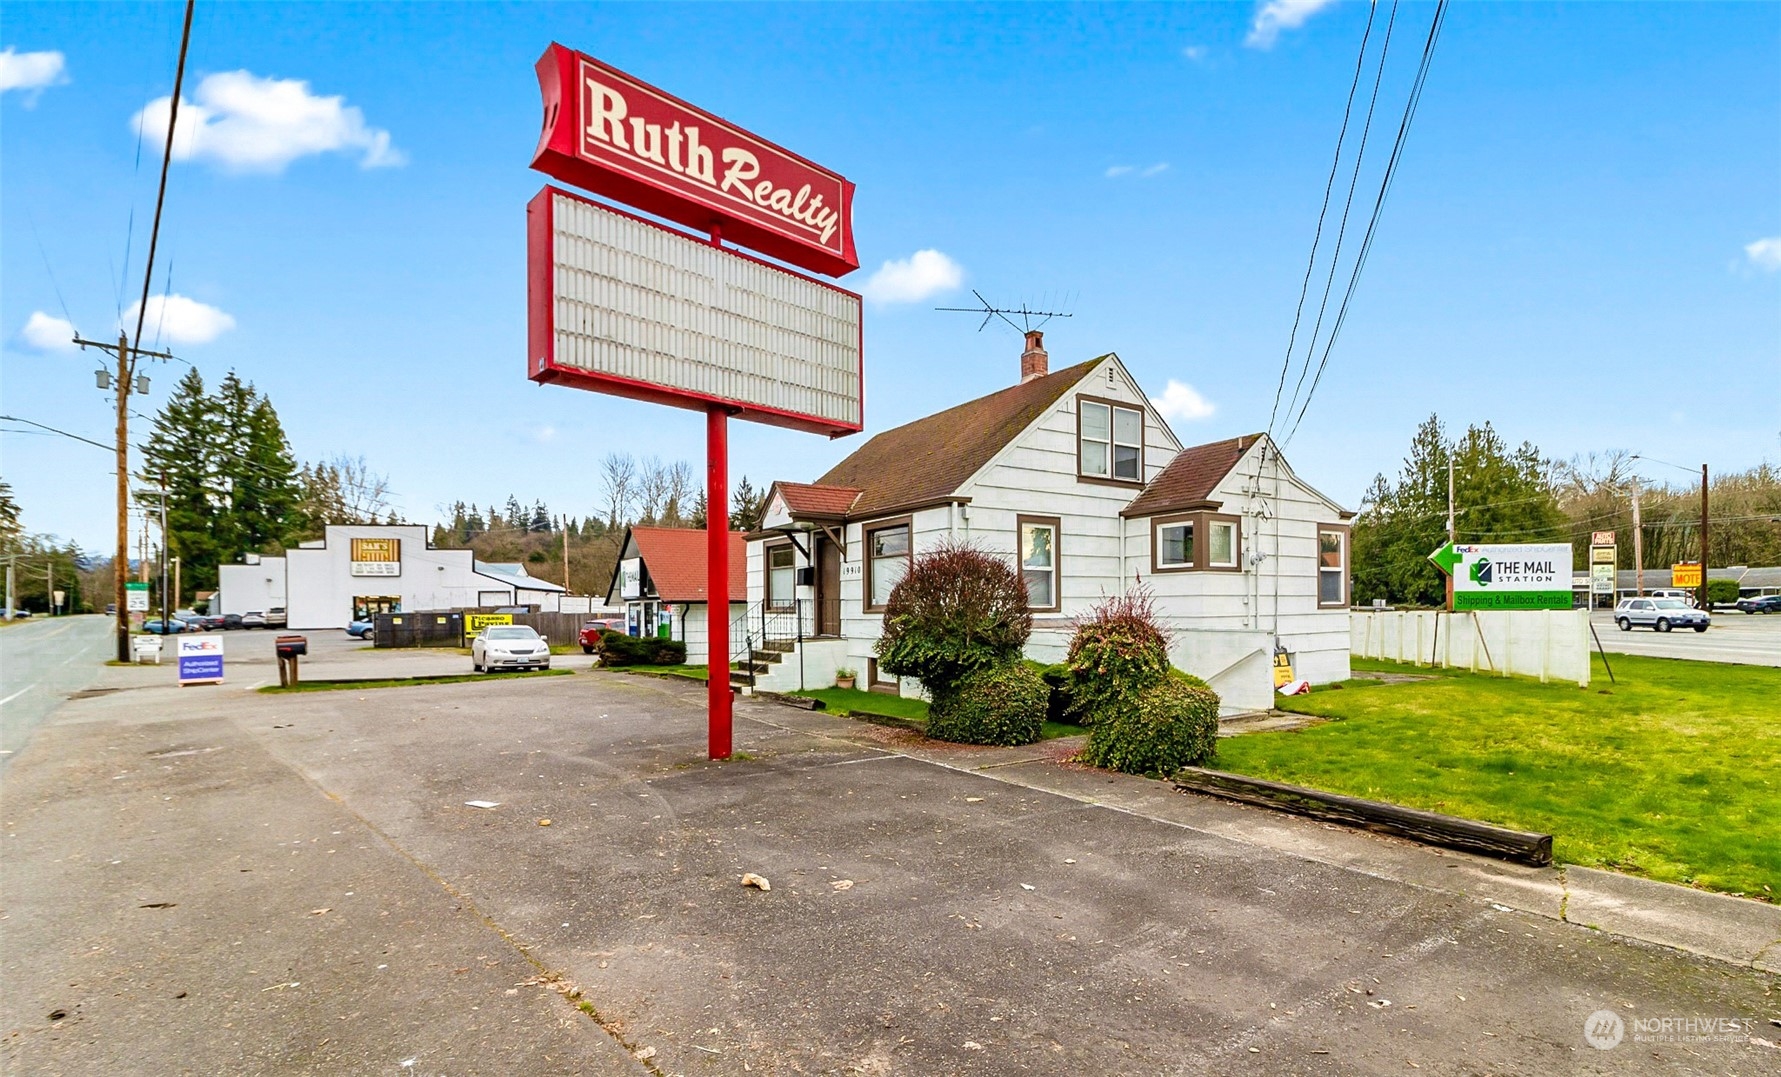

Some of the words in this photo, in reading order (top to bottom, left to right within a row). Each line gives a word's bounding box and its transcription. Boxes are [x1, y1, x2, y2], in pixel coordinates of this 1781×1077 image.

[586, 77, 717, 187] Ruth
[721, 147, 838, 245] Realty
[1496, 562, 1520, 574] THE
[1523, 562, 1555, 574] MAIL
[1675, 573, 1701, 585] MOTE
[130, 600, 146, 608] 25
[1457, 595, 1493, 607] Shipping
[1495, 596, 1501, 604] &
[1503, 595, 1535, 604] Mailbox
[1537, 595, 1569, 604] Rentals
[183, 641, 217, 650] FedEx
